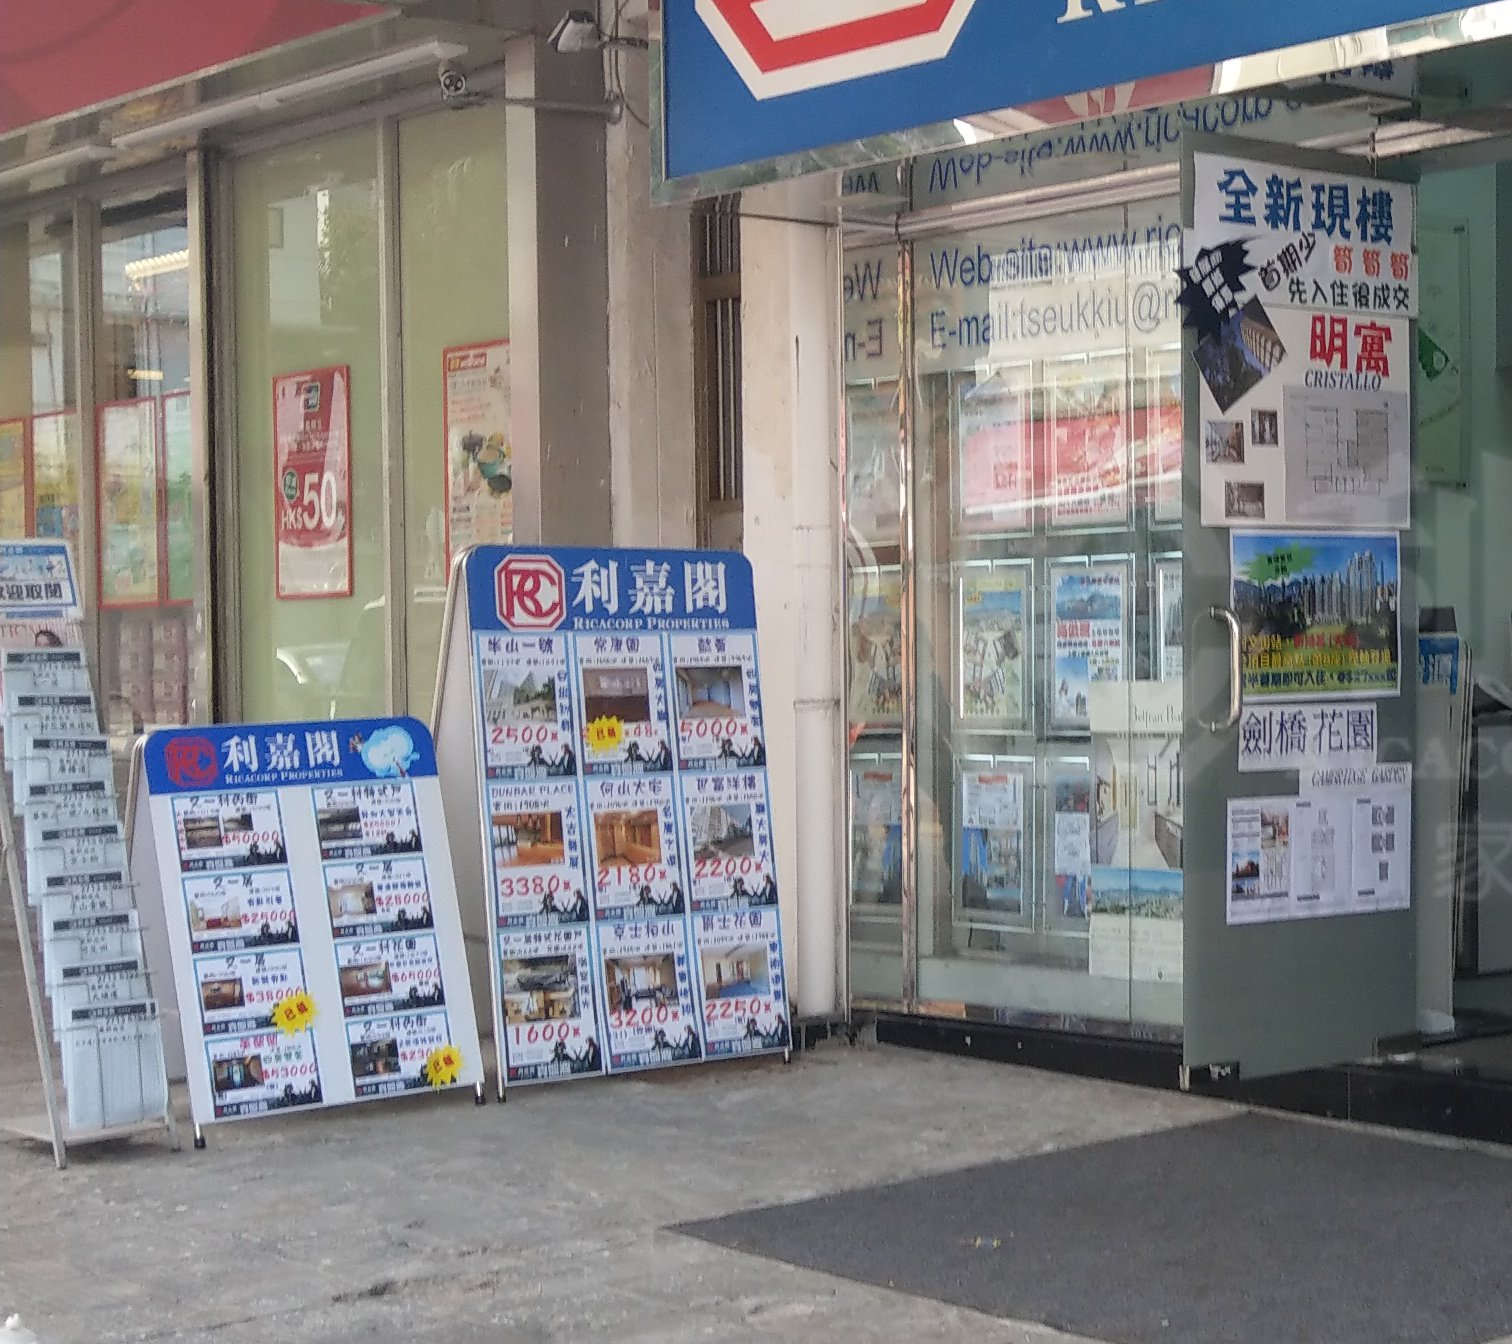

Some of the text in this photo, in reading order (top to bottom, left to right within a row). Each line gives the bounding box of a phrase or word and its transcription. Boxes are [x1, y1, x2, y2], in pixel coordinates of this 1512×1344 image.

[1216, 167, 1395, 245] 全新現樓
[1288, 278, 1411, 312] 先入住後成交
[1304, 368, 1383, 393] CRISTALLO
[571, 558, 727, 616] 利嘉閣
[573, 616, 643, 632] RICACORP
[221, 729, 342, 773] 利嘉閣
[1241, 708, 1375, 757] 劍橋花園
